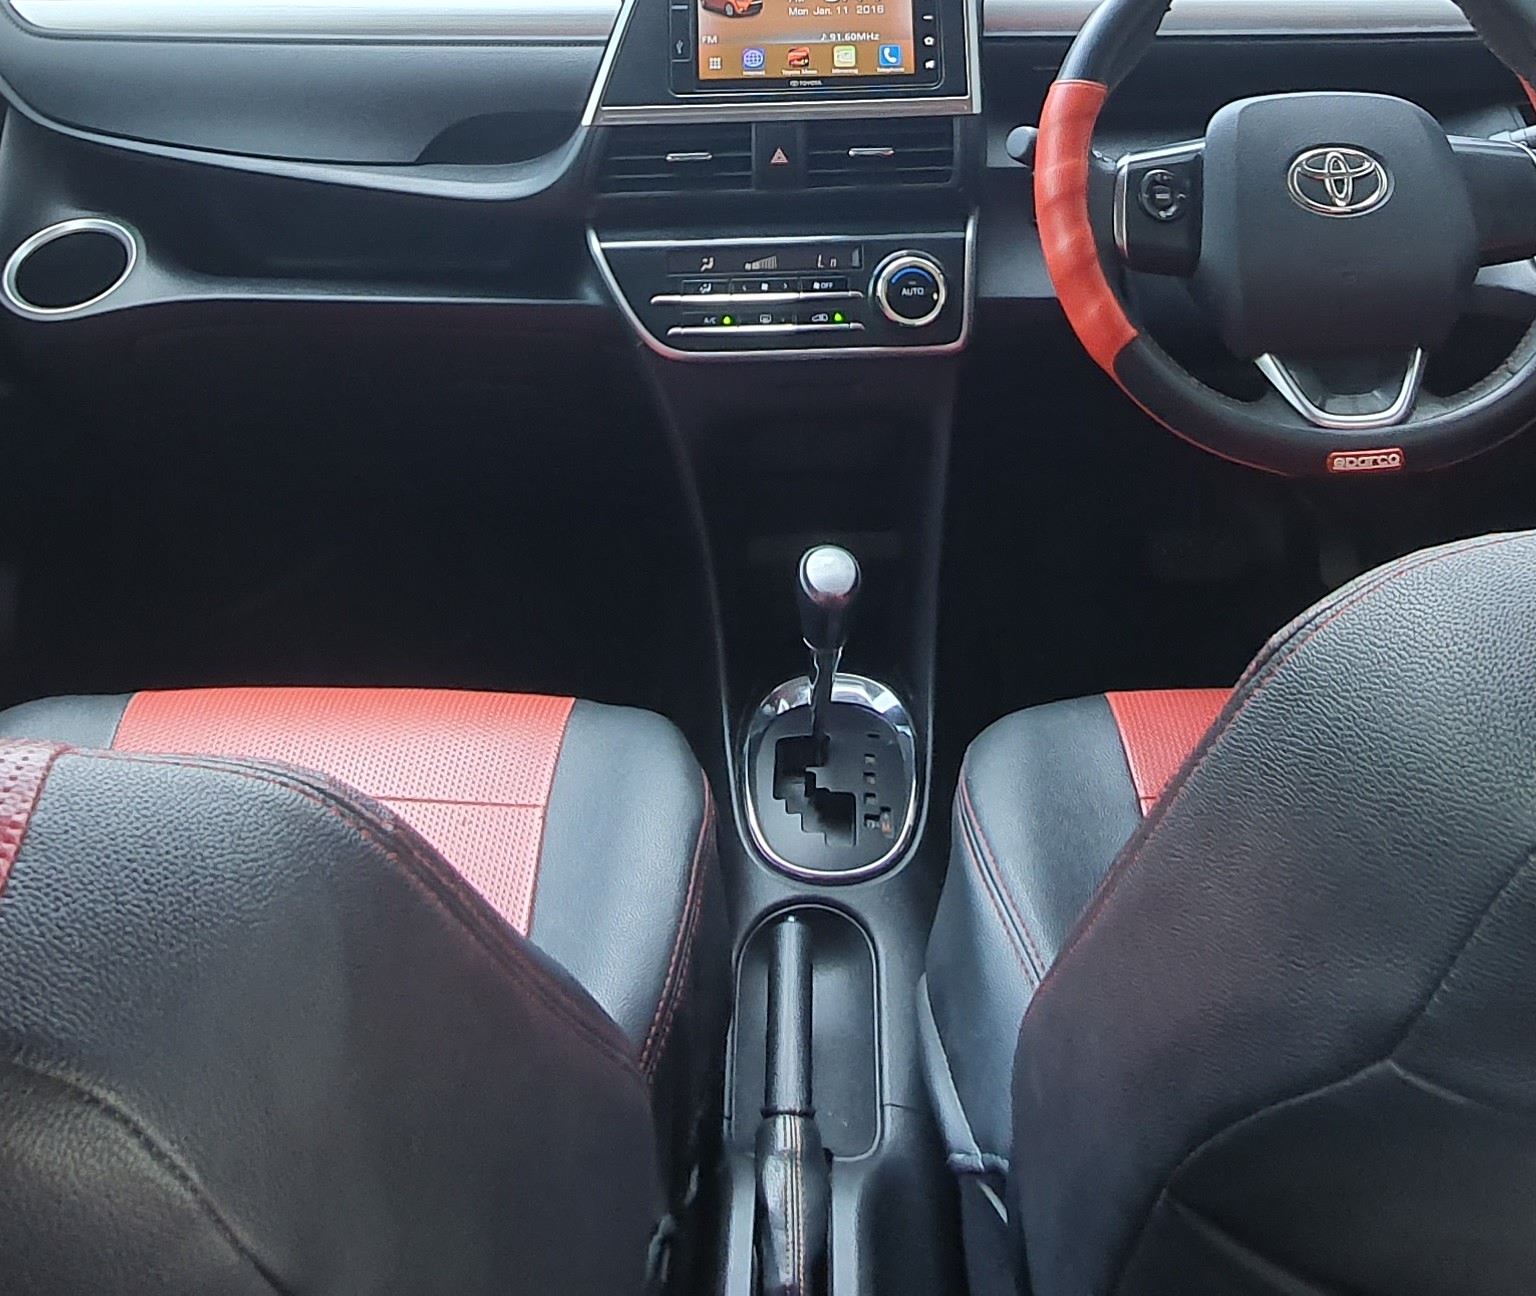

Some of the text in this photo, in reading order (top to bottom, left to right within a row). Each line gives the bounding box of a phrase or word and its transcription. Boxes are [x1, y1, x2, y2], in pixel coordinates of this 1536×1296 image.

[788, 7, 809, 17] Mon
[836, 6, 849, 15] 11
[701, 35, 718, 45] FM
[829, 32, 880, 42] 91.60MHz
[820, 281, 833, 290] OFF
[901, 287, 924, 296] AUTO
